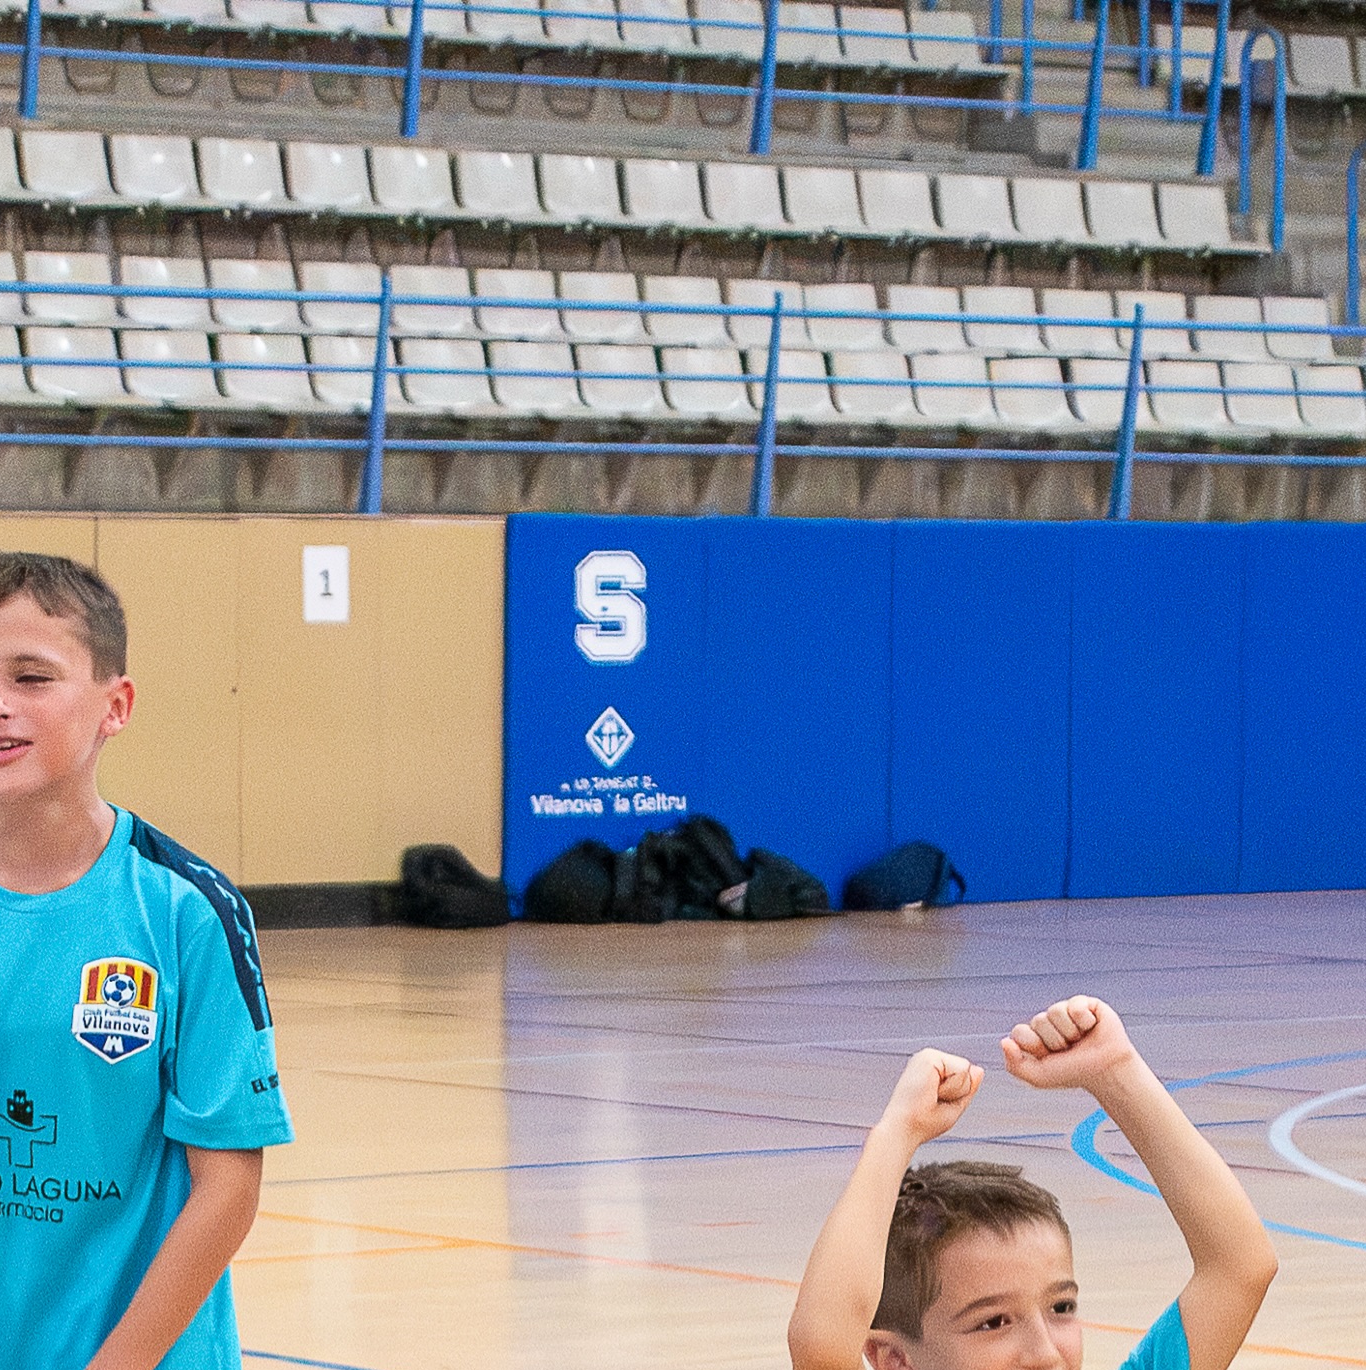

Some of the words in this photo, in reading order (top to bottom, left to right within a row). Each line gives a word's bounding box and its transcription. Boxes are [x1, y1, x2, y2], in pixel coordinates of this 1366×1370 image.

[319, 569, 333, 597] 1
[574, 550, 647, 662] S
[82, 1015, 150, 1036] Vilanova
[12, 1172, 122, 1203] LAGUNA
